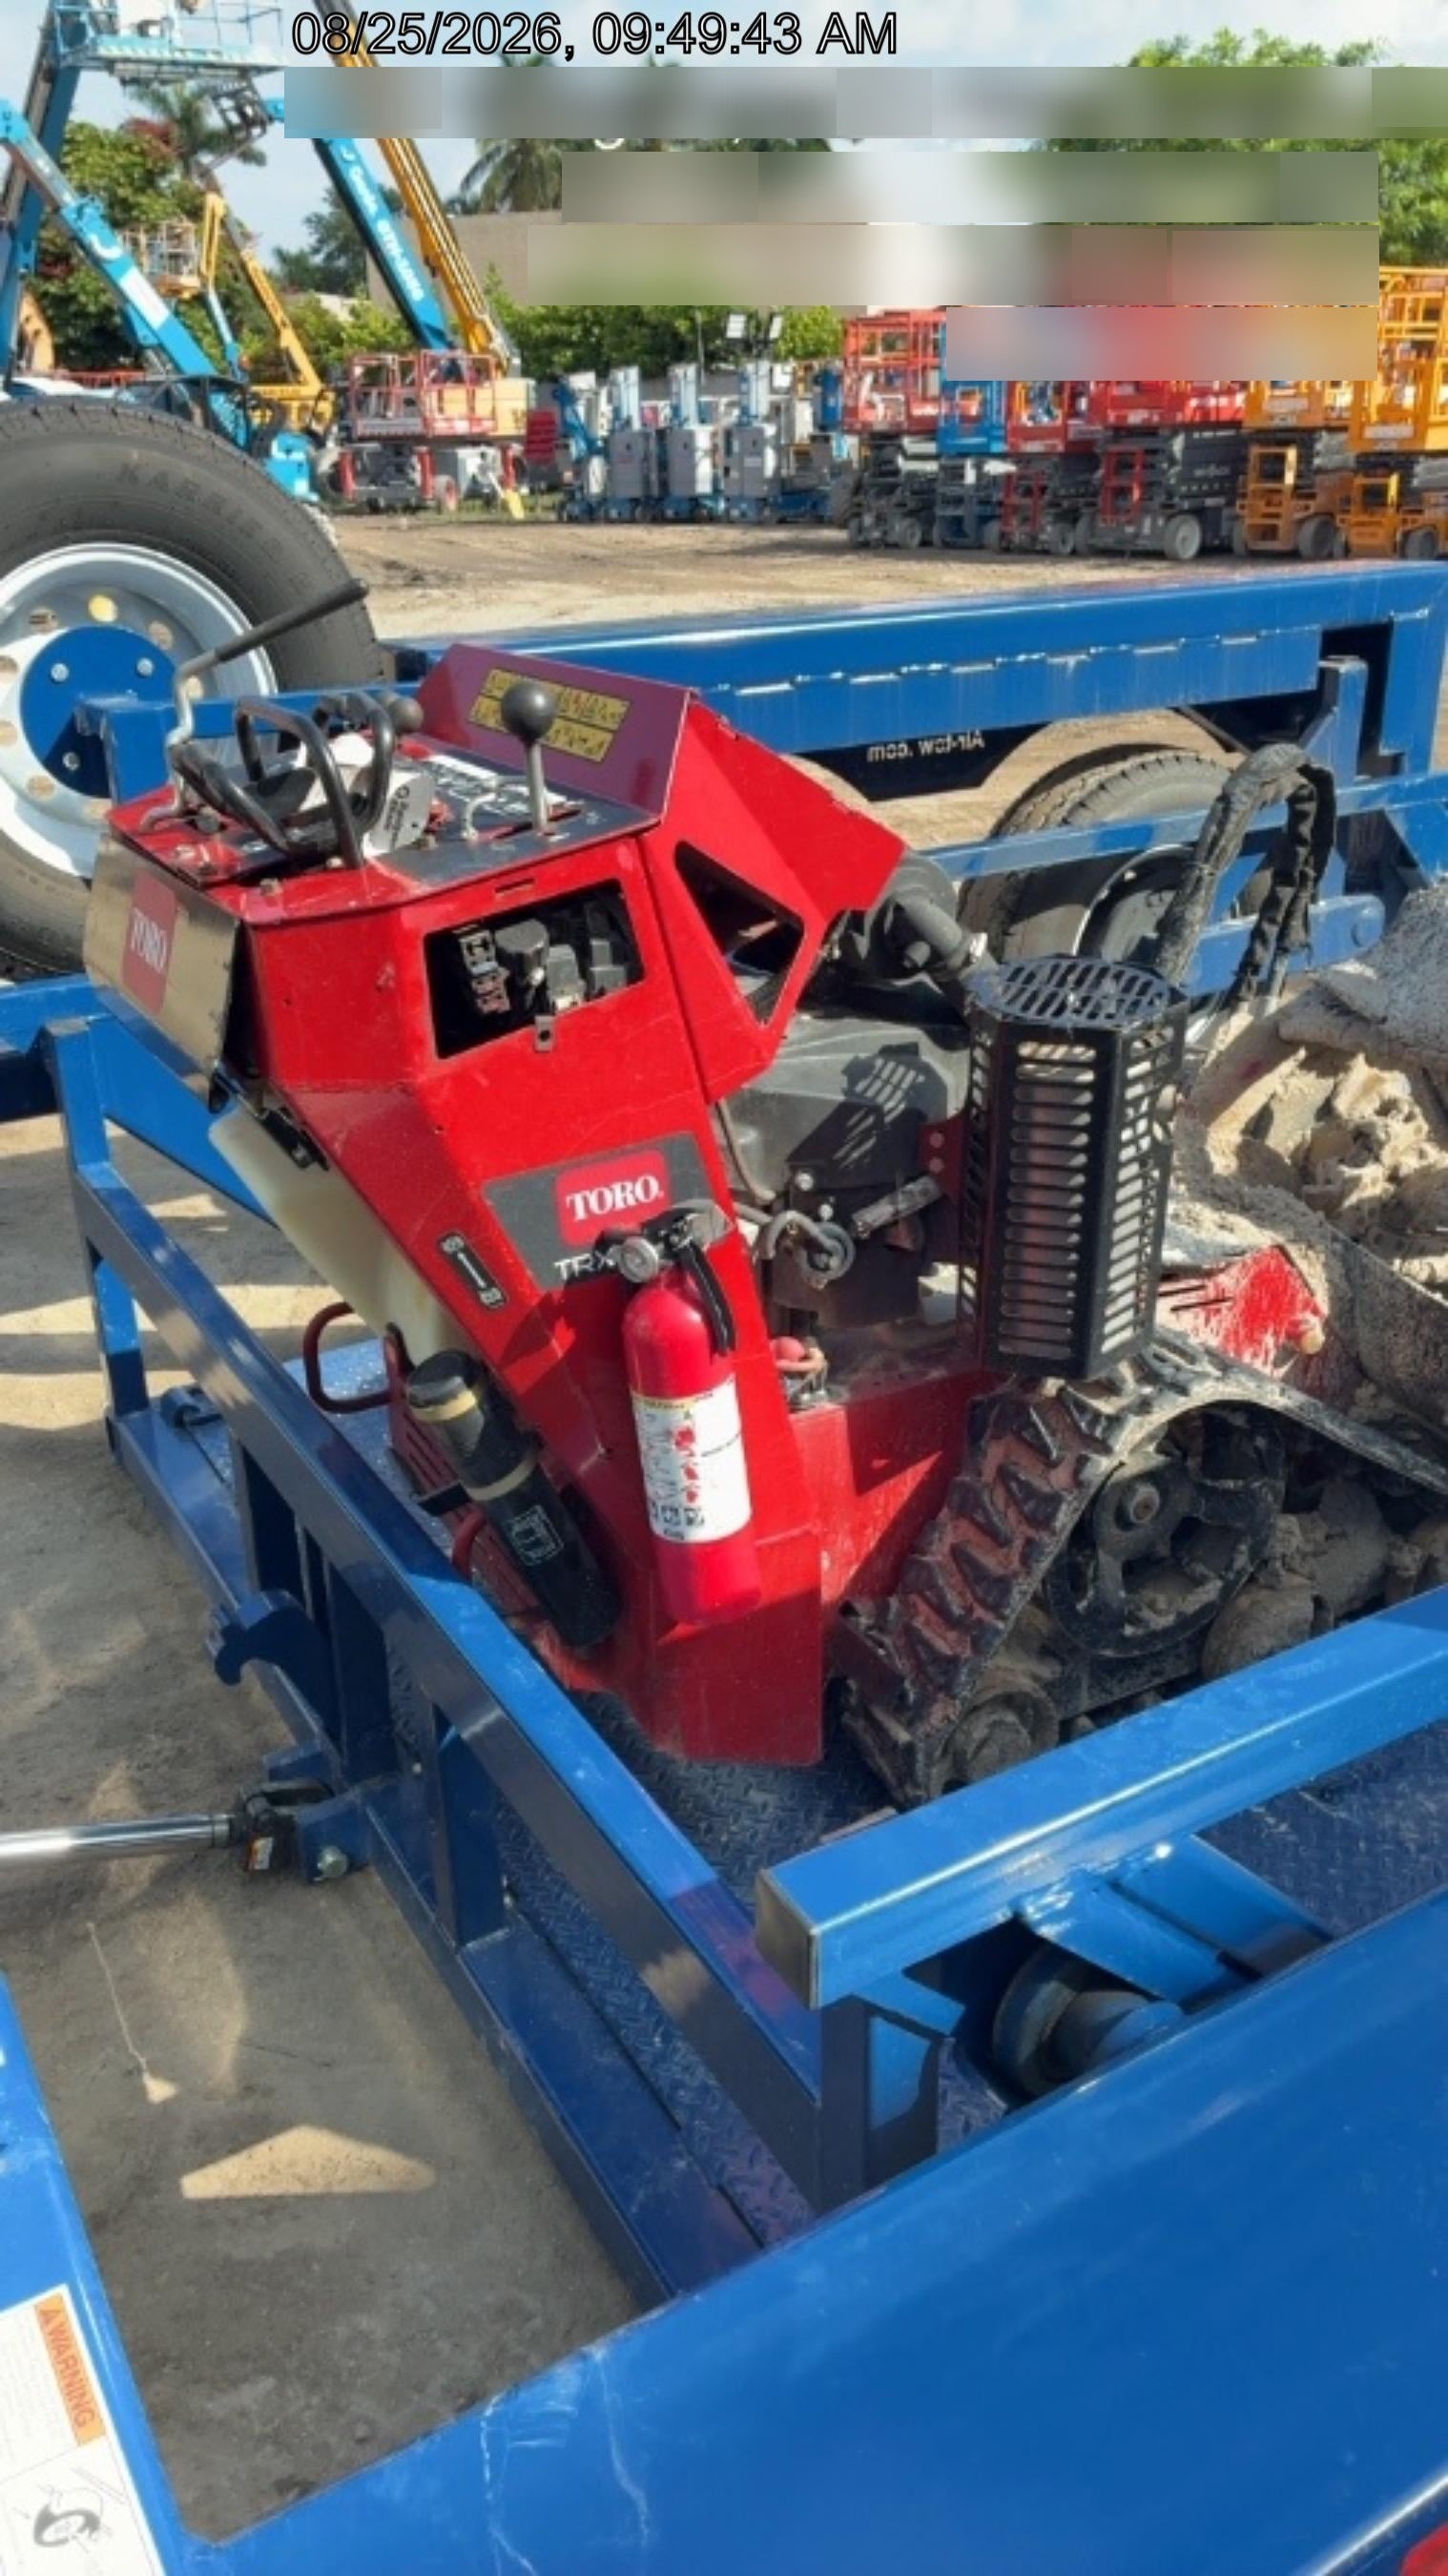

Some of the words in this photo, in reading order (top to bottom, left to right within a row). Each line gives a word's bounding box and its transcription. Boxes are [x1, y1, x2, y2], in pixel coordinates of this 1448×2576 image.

[131, 906, 168, 974] TORO
[566, 1174, 661, 1221] TORO
[46, 2324, 96, 2429] WARNING
